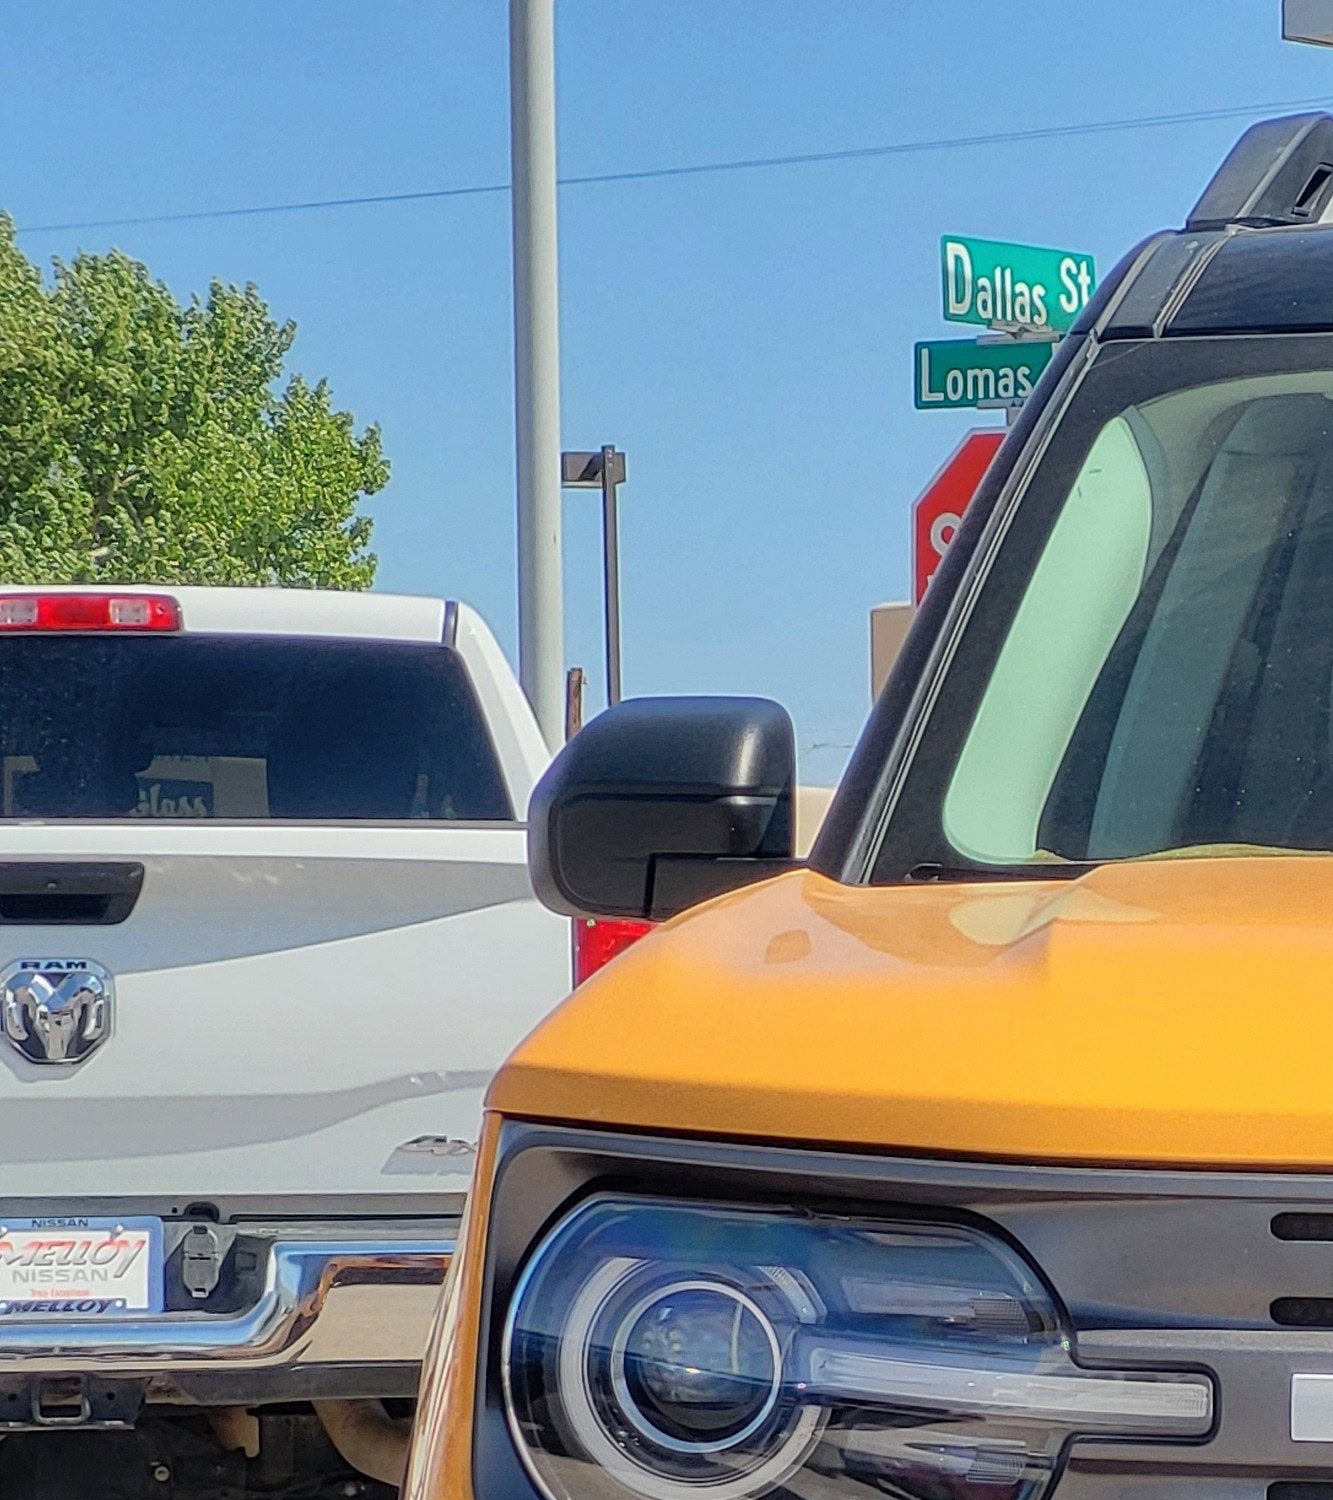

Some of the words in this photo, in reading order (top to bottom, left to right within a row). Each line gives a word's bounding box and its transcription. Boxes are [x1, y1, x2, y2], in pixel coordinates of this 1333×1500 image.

[946, 241, 1047, 325] Dallas
[1059, 257, 1092, 313] St
[921, 347, 1034, 402] Lomas
[31, 1218, 89, 1228] NISSAN
[12, 1269, 108, 1283] NISSAN
[4, 1299, 113, 1315] MELLOY
